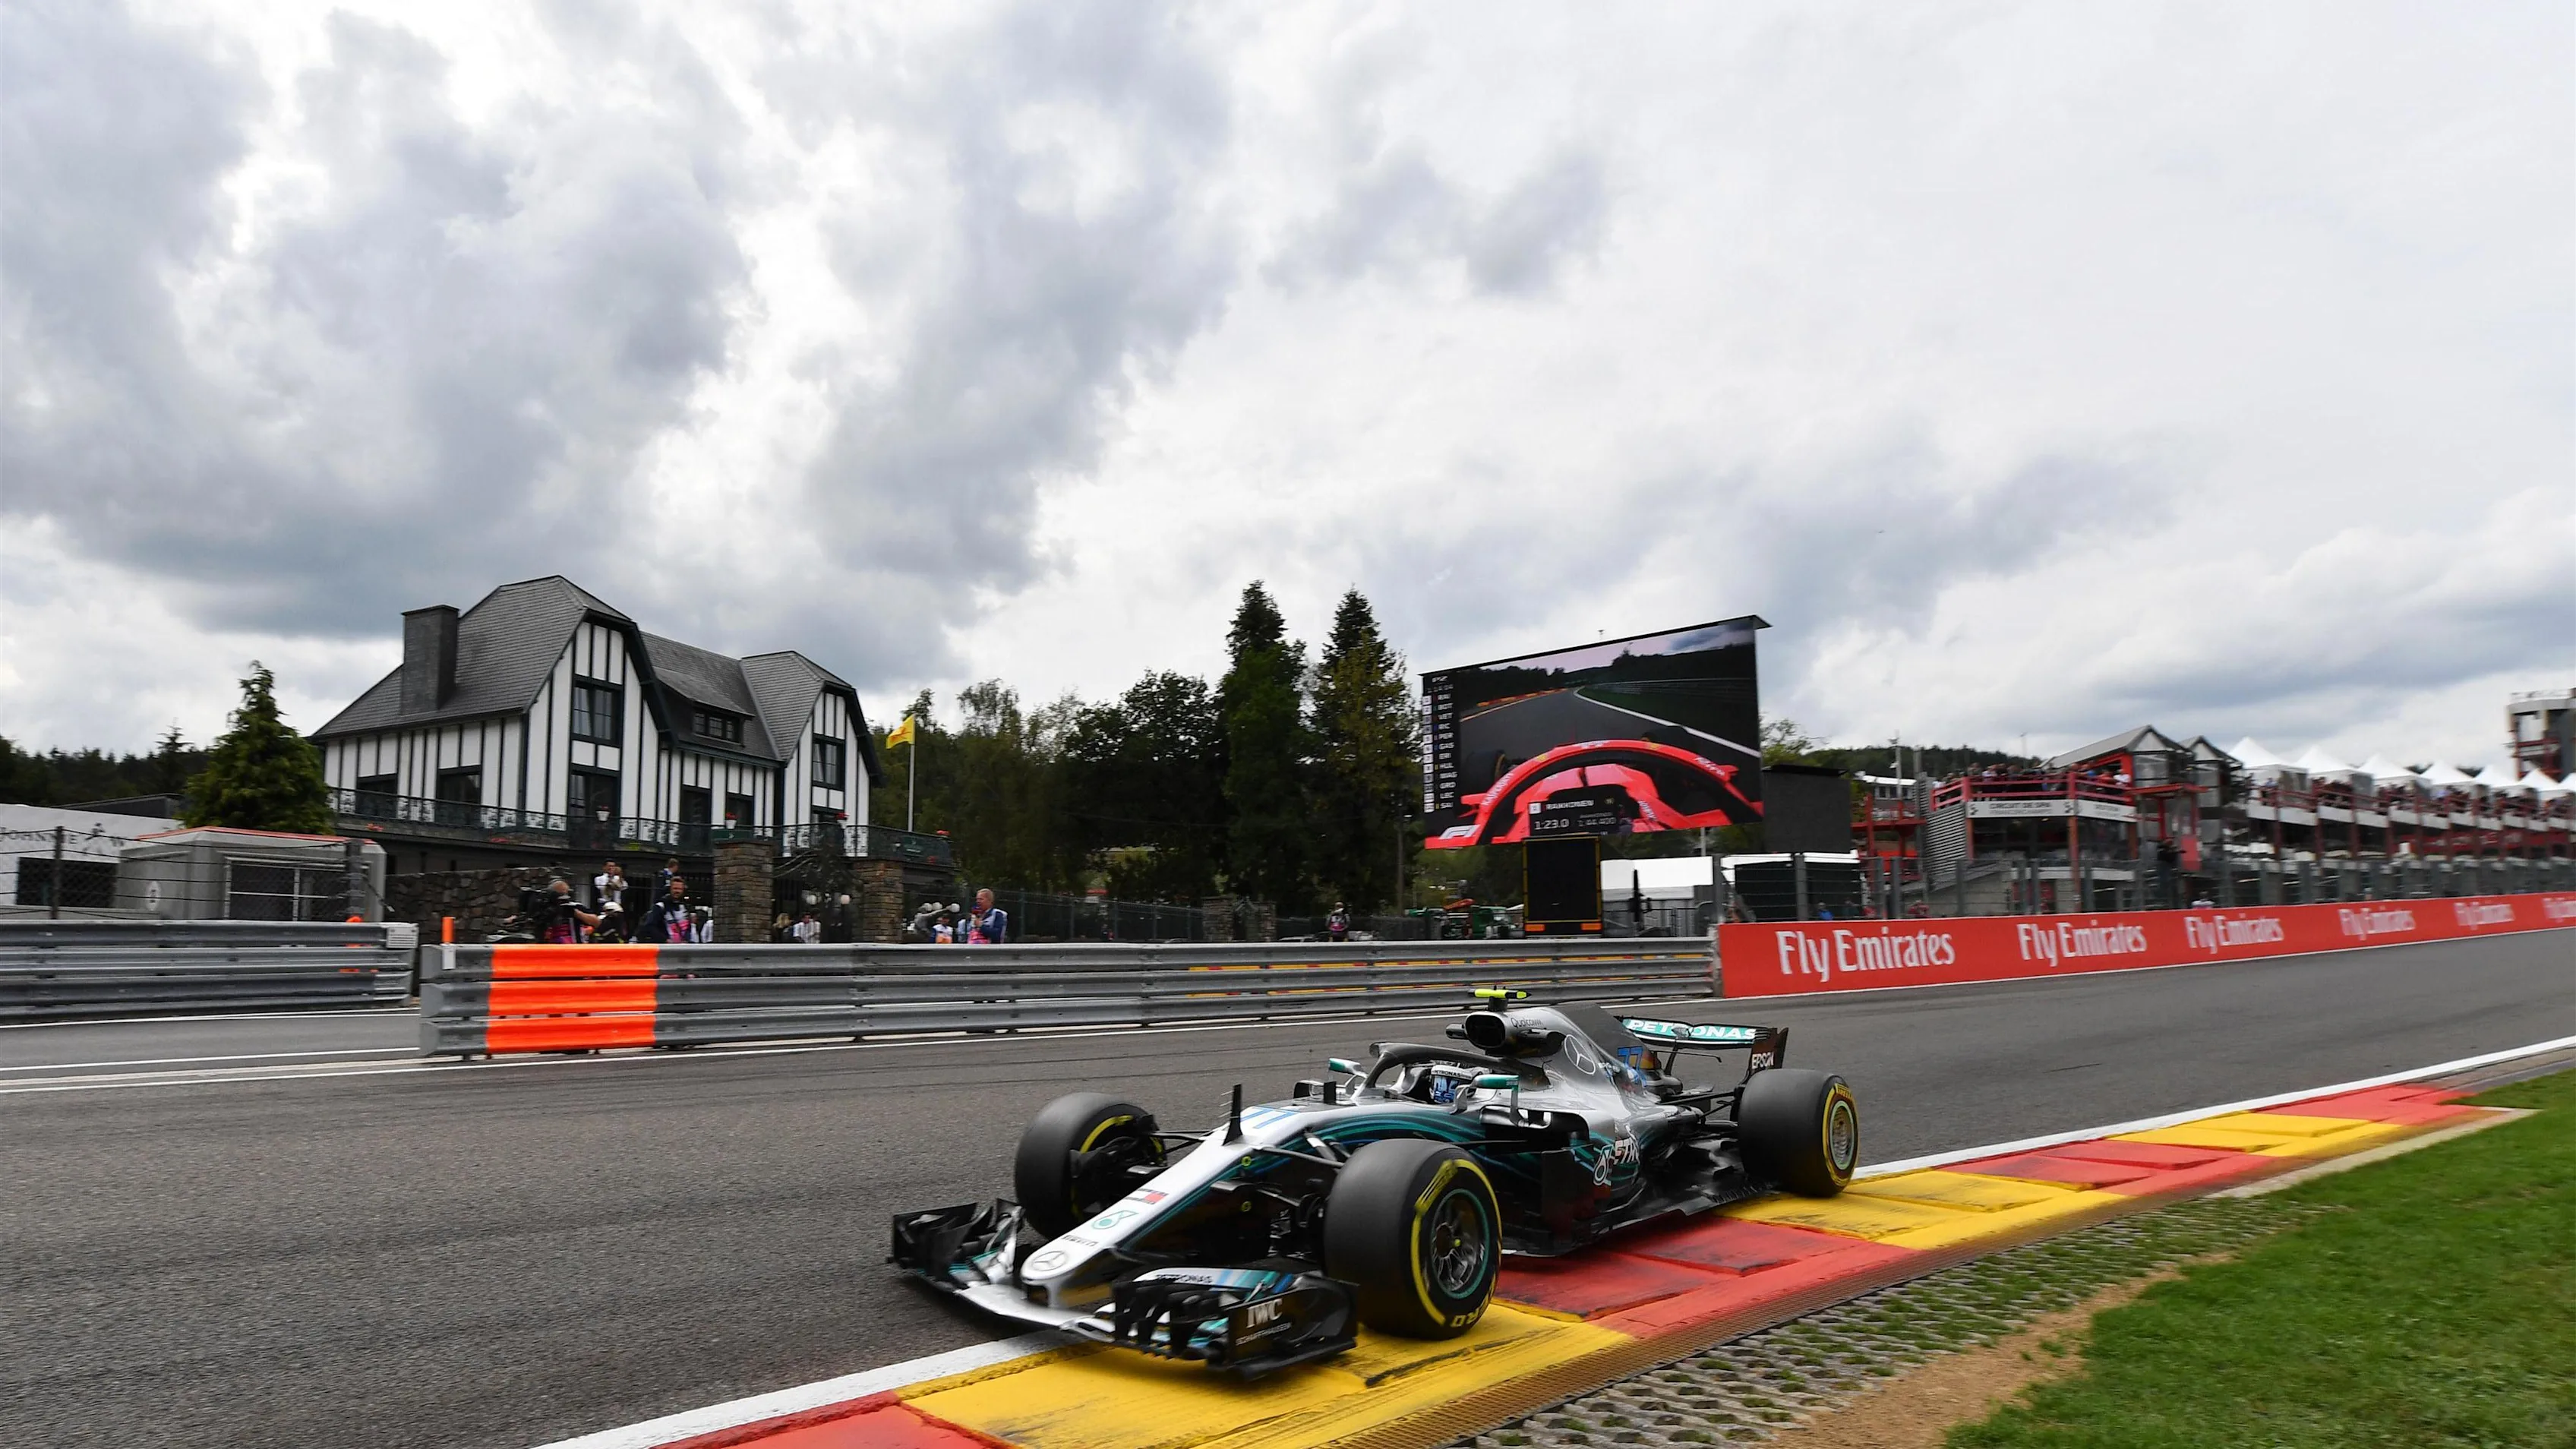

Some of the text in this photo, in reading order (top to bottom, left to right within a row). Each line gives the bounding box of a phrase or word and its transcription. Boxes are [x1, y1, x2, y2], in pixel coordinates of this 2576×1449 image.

[1534, 819, 1570, 830] 1:23.0
[2184, 913, 2284, 955] Fly Emirates
[2338, 904, 2416, 941] Fly Emirates
[1776, 926, 1956, 983] Fly Emirates
[2017, 919, 2148, 968] Fly Emirates
[1751, 1052, 1775, 1071] EPSON
[1246, 1298, 1283, 1329] IWC
